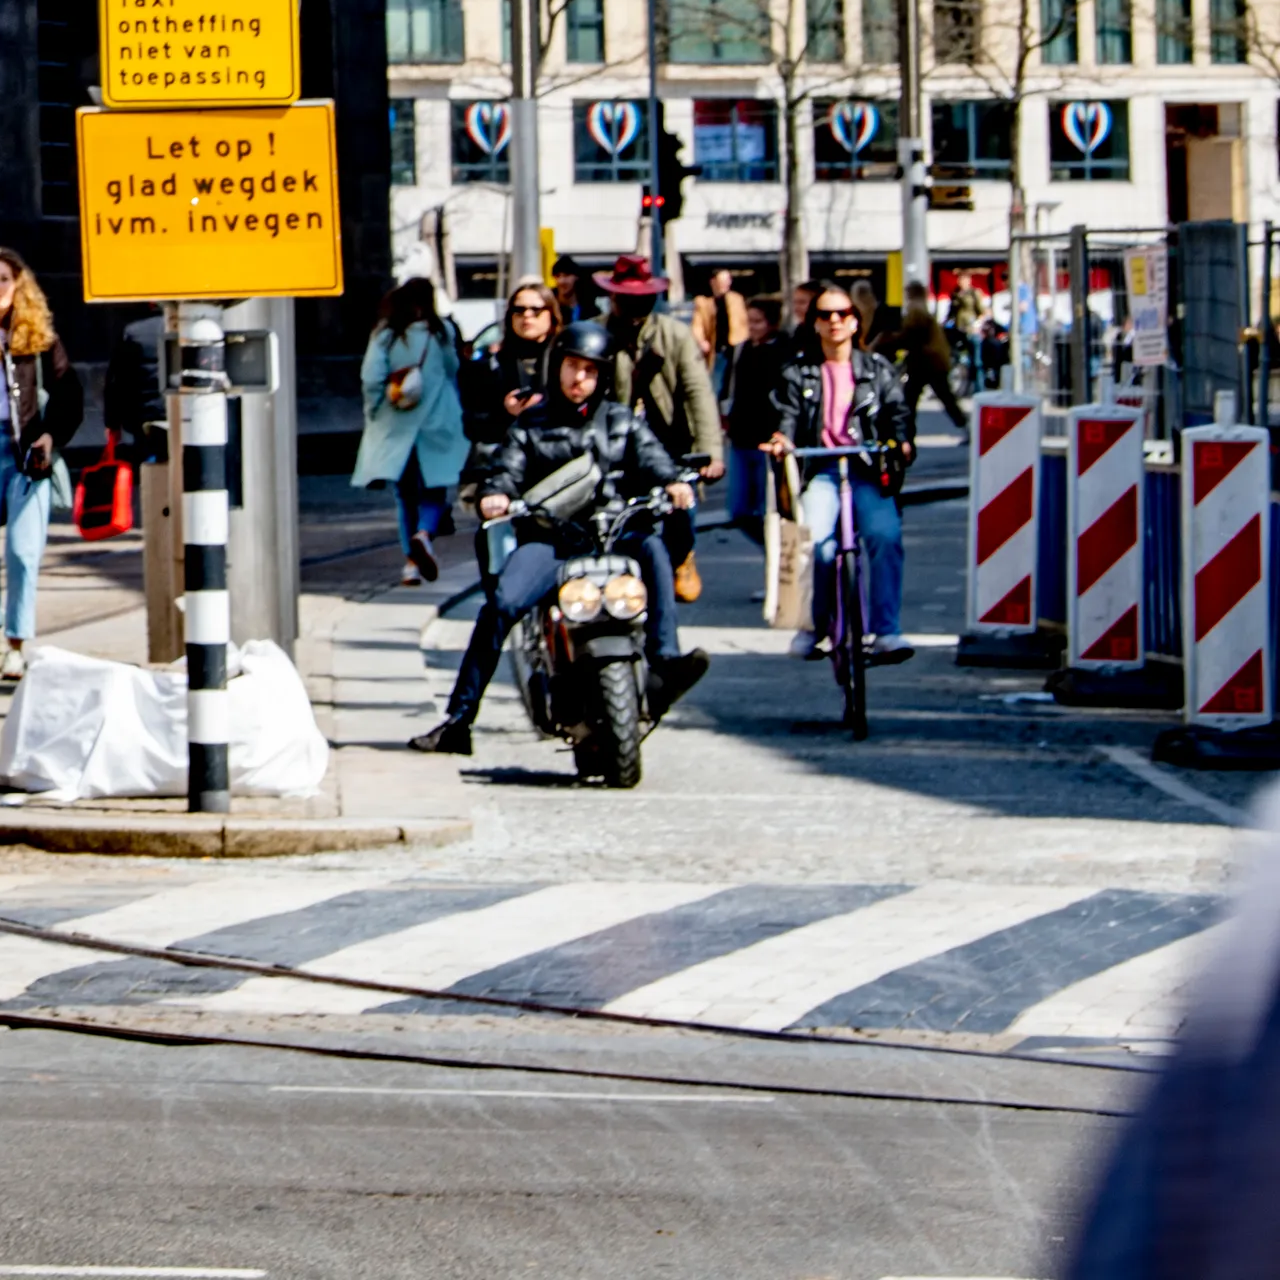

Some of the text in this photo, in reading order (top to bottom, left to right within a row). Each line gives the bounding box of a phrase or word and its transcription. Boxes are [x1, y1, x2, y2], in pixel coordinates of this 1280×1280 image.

[119, 15, 260, 37] ontheffing
[120, 42, 229, 59] niet van
[120, 68, 265, 89] toepassing
[147, 136, 200, 159] Let
[106, 170, 318, 204] glad wegdek
[96, 211, 322, 238] ivm. invegen
